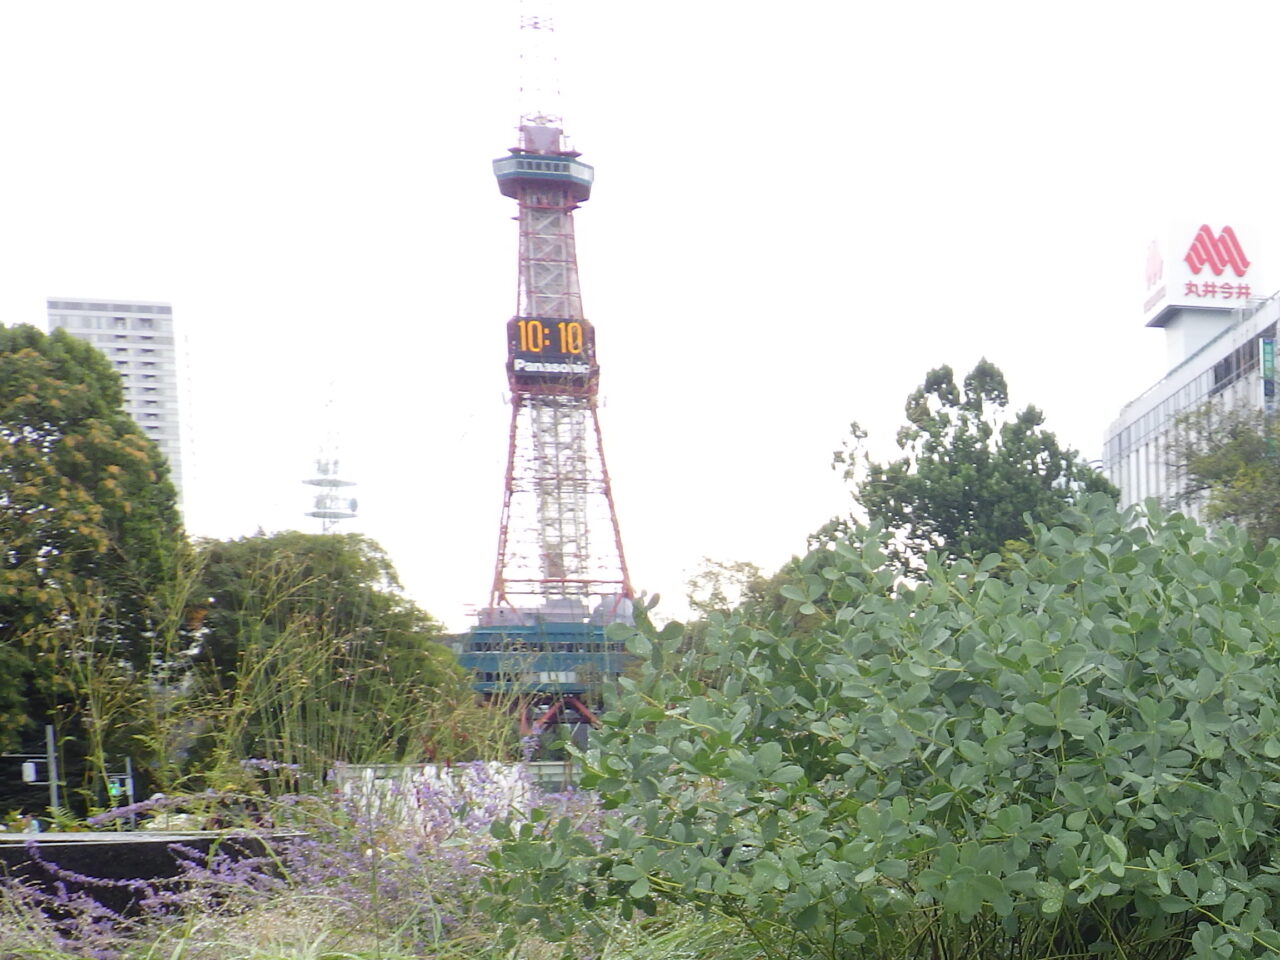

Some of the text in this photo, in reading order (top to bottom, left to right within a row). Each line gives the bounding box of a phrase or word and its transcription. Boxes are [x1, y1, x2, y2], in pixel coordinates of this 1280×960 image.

[1184, 280, 1251, 299] 丸井今井
[513, 358, 591, 373] Panasonic
